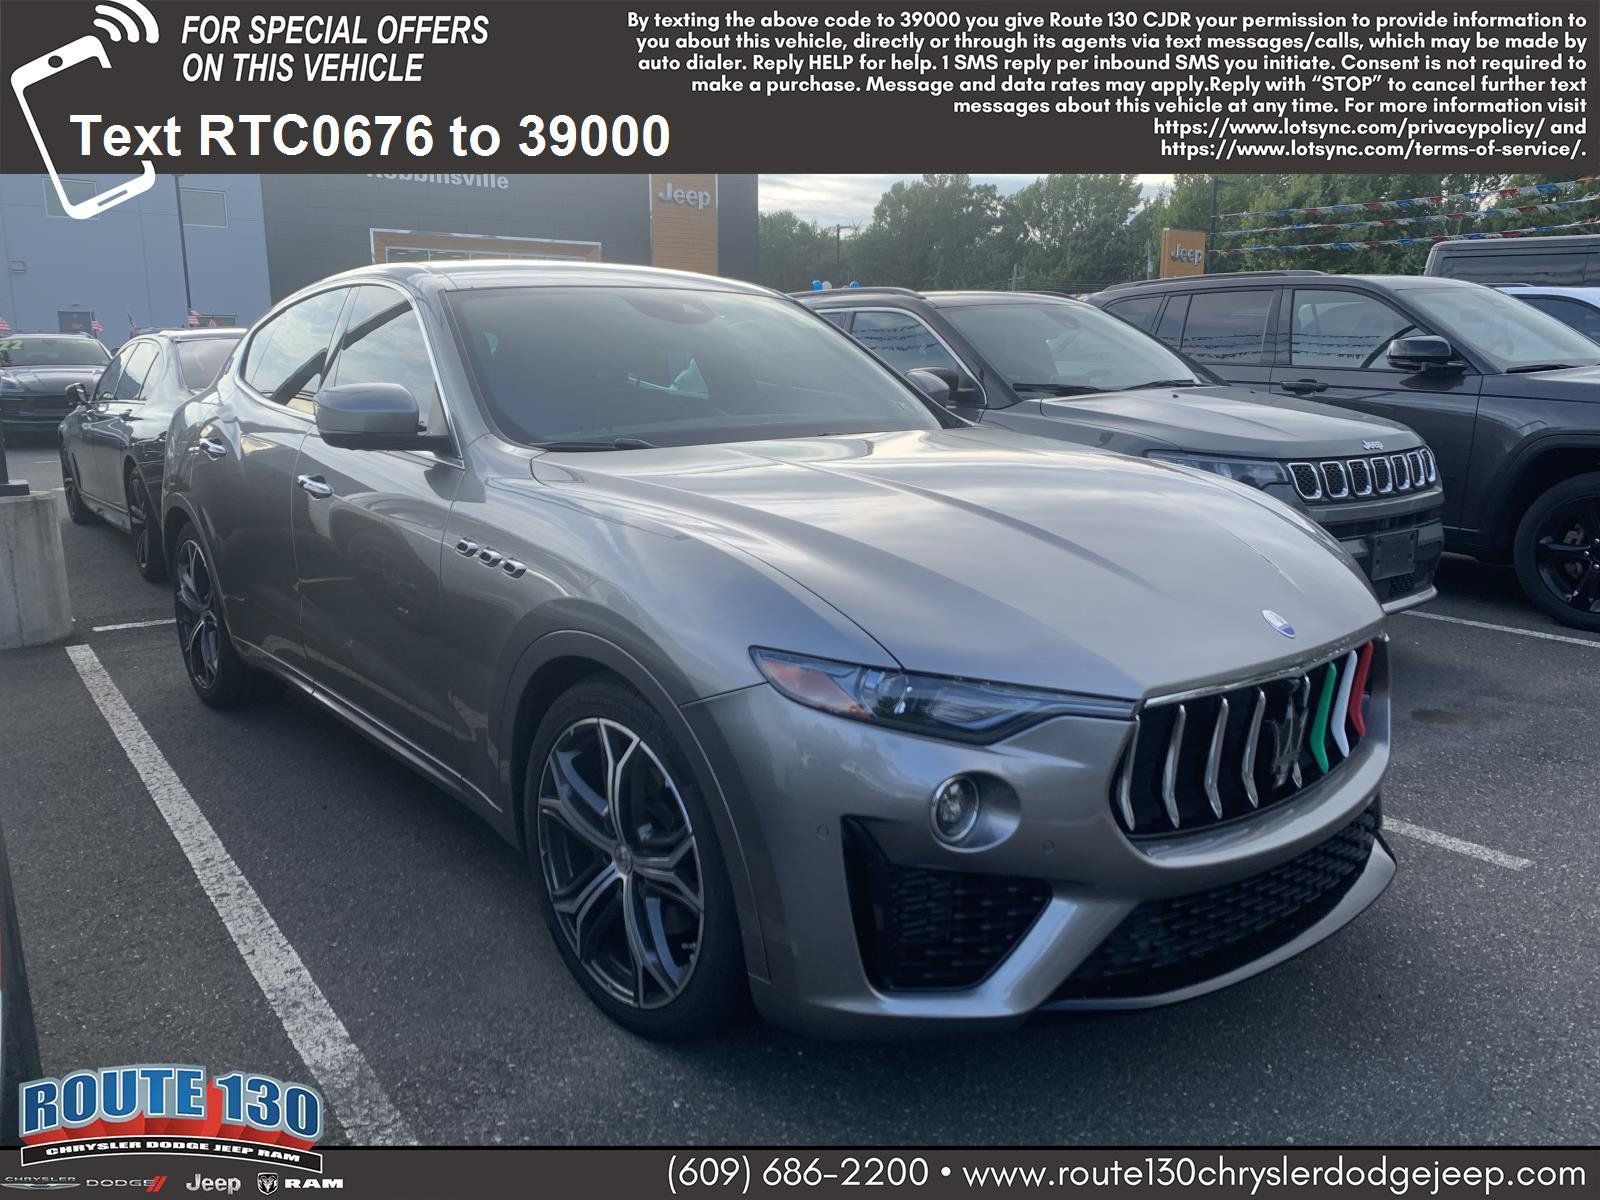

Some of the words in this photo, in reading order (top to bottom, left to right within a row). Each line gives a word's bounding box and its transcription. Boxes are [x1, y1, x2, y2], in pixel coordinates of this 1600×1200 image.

[366, 174, 510, 189] insville
[657, 182, 711, 210] Jeep
[1171, 243, 1202, 265] Jeep
